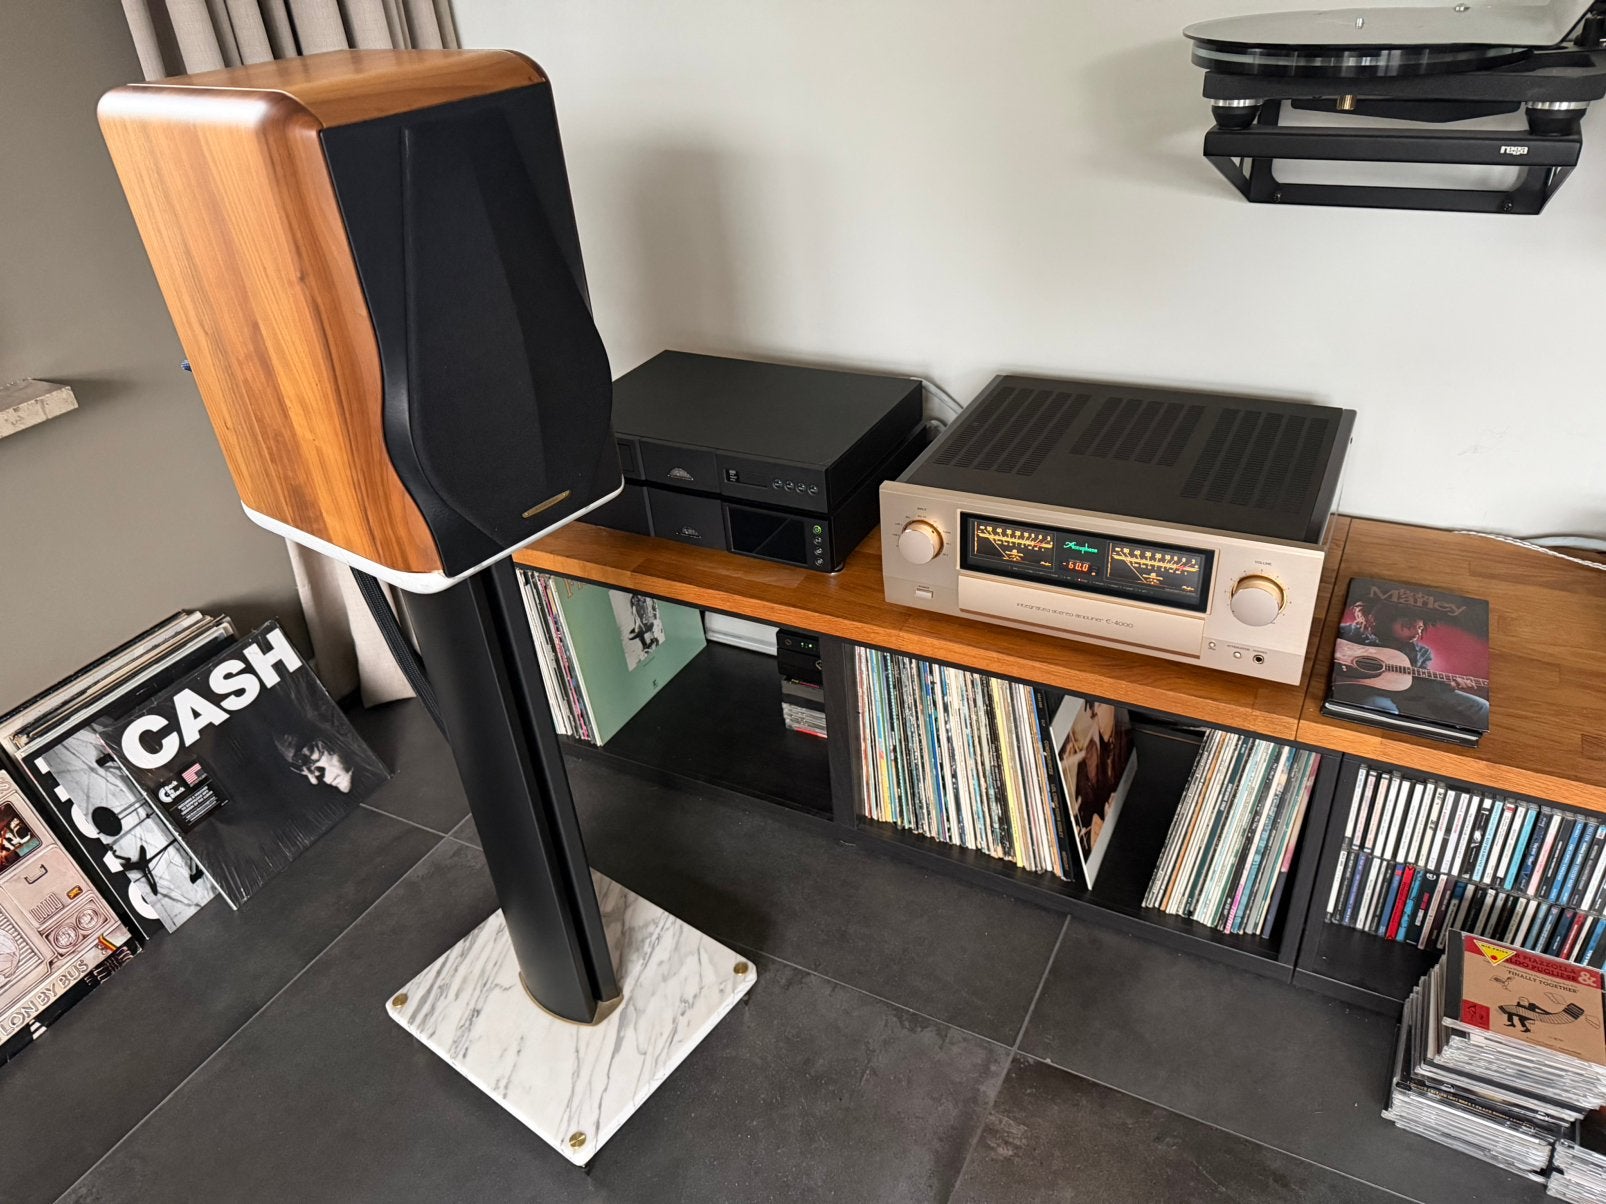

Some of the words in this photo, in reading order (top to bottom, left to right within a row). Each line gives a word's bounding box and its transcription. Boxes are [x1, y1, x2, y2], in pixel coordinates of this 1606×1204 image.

[1500, 146, 1528, 155] rega
[1369, 586, 1467, 616] Marley
[121, 628, 303, 769] CASH
[36, 983, 58, 1007] BY
[58, 959, 89, 990] BUS
